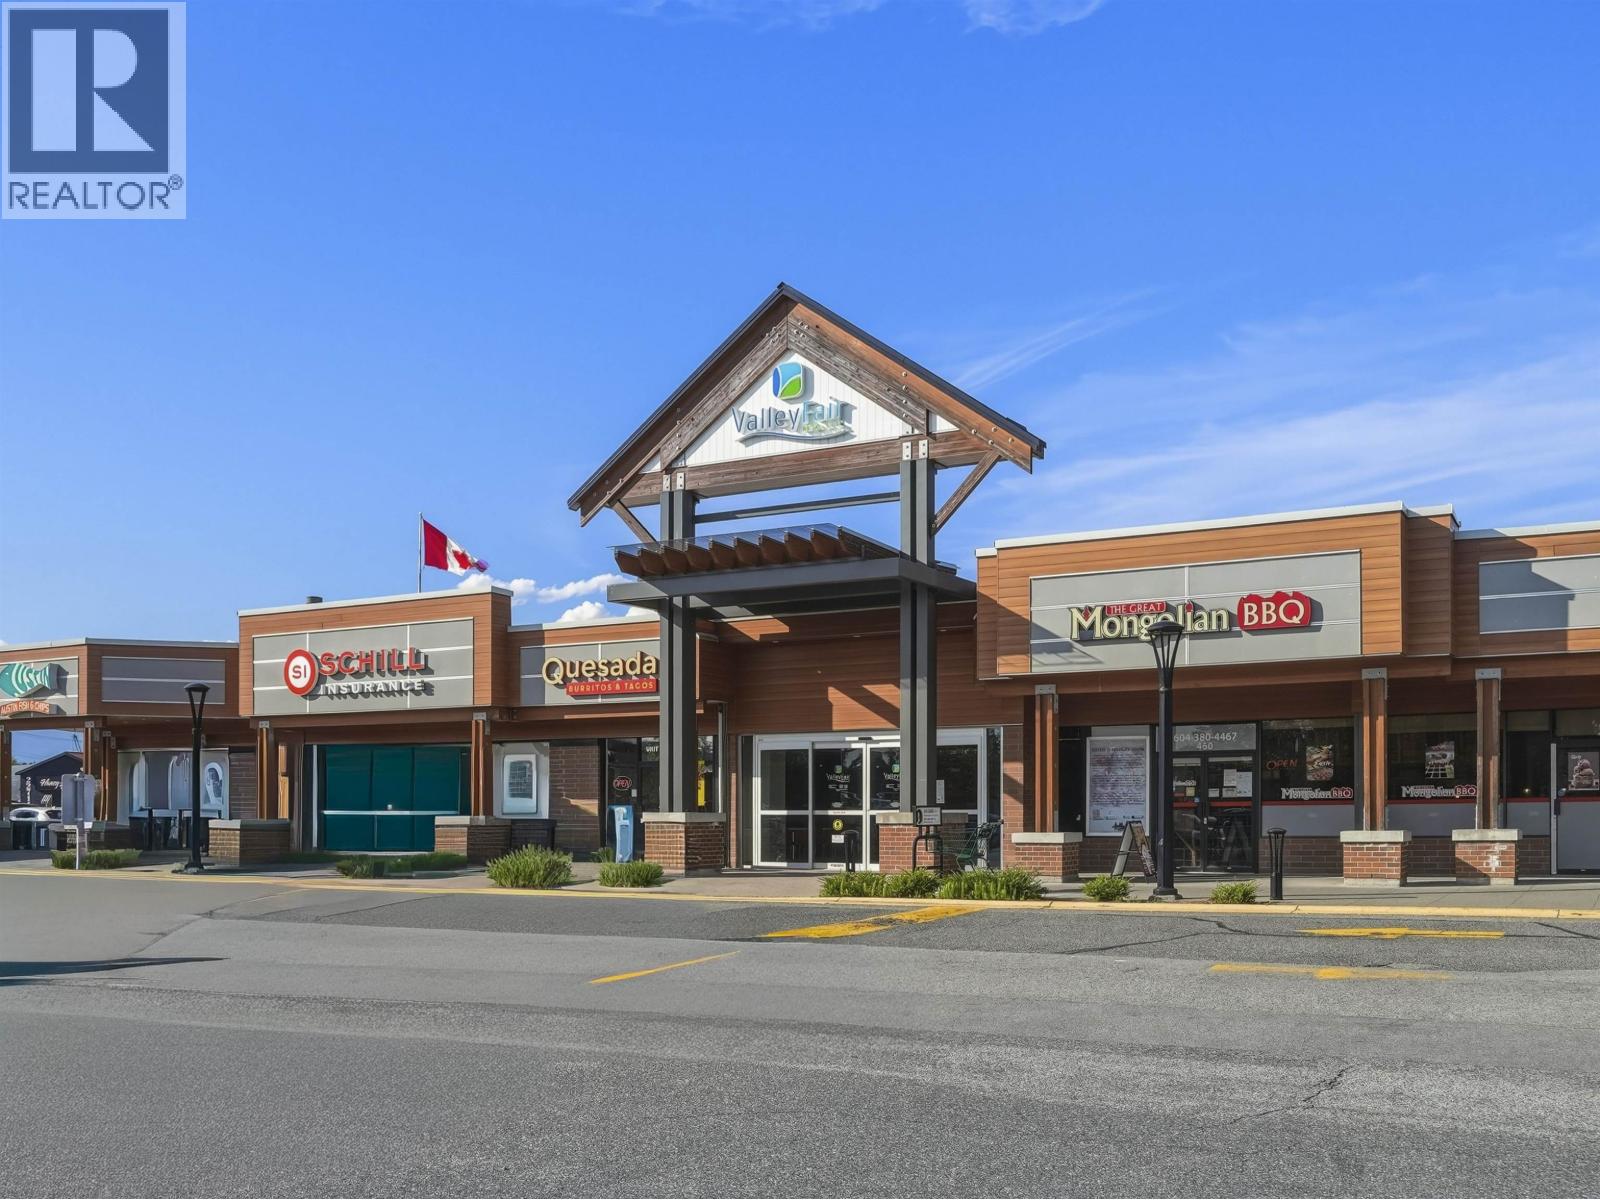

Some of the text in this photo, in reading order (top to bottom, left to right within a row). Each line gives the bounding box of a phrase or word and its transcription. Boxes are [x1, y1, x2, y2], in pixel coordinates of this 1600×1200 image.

[1109, 601, 1163, 614] THE GREAT
[1243, 598, 1306, 627] BBQ
[319, 647, 425, 676] SCHILL
[541, 650, 658, 685] Quesada
[319, 679, 424, 696] INSURANCE
[568, 681, 654, 693] BURRITOS & TACOS
[1266, 759, 1298, 770] OPEN
